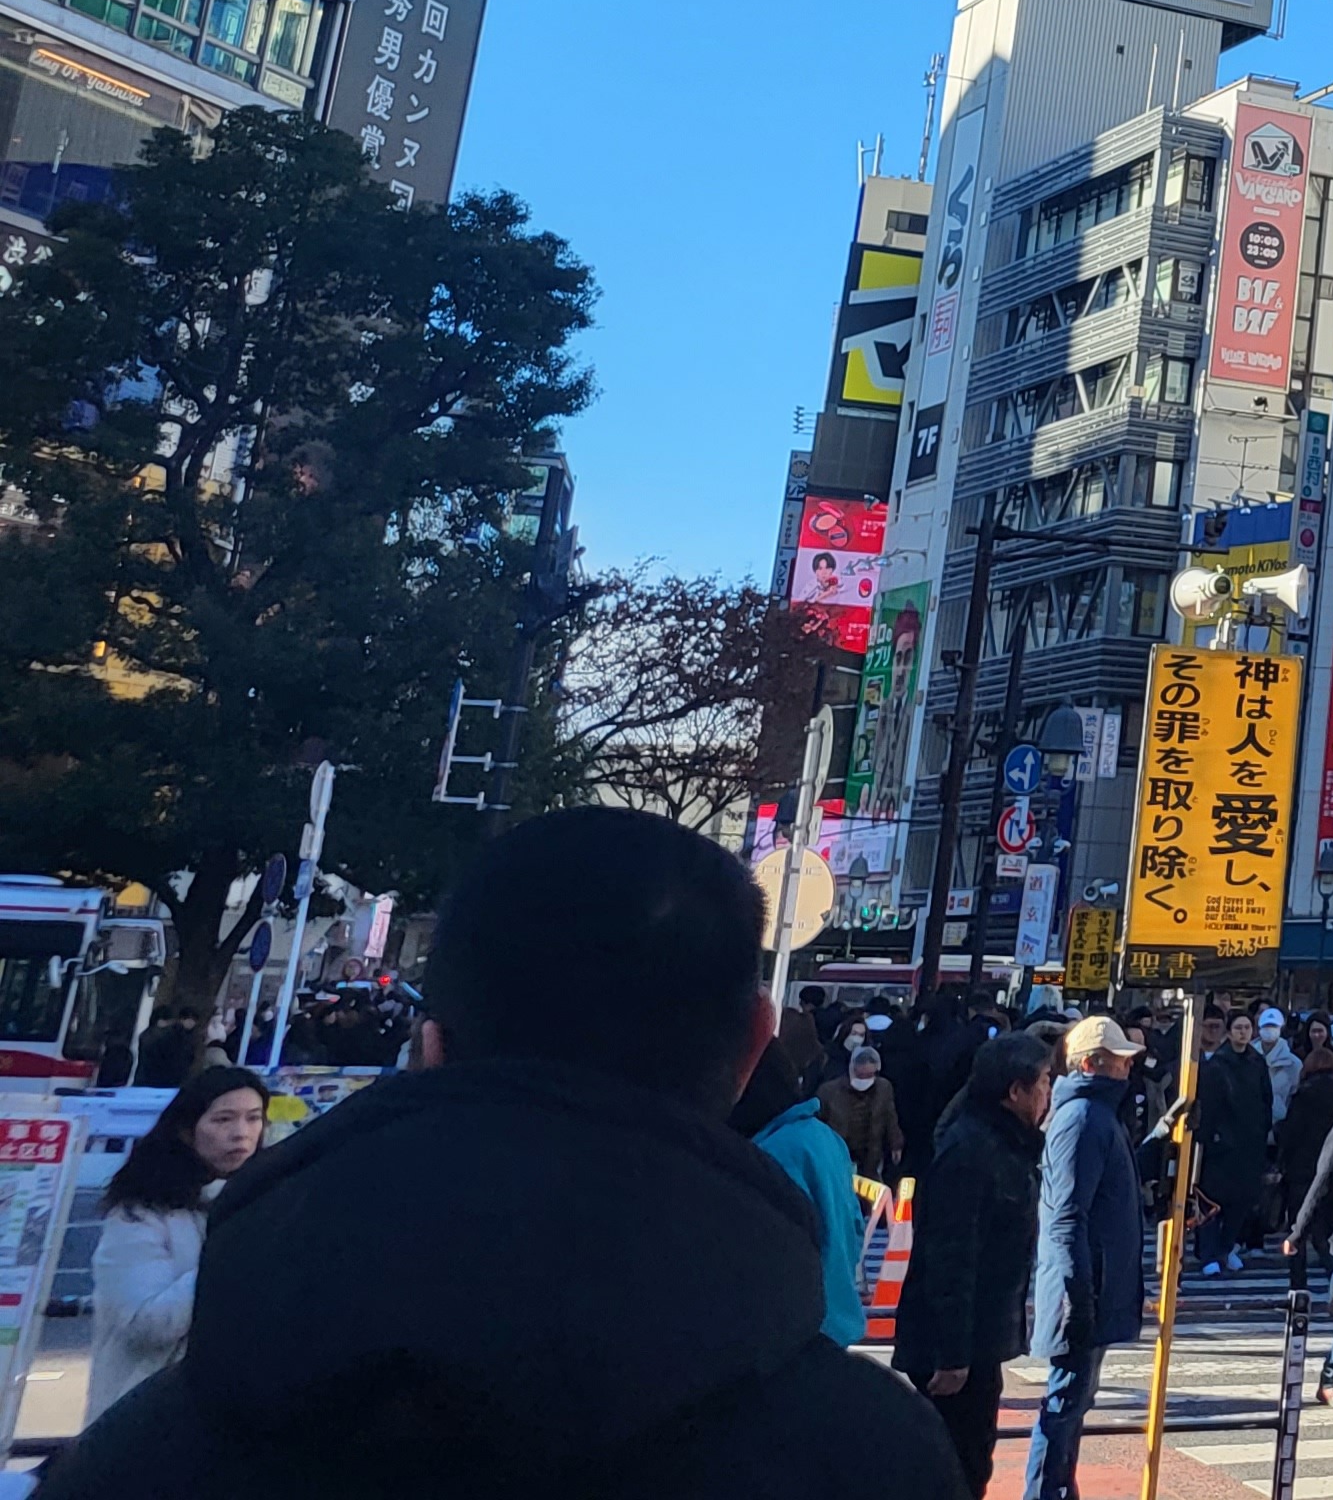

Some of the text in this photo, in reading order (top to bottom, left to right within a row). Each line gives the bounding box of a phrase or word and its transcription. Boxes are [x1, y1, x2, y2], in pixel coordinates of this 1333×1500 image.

[1235, 172, 1302, 208] VANGUARD
[1248, 233, 1280, 247] 10:00
[1237, 276, 1281, 305] B1F
[1233, 307, 1279, 336] B2F
[917, 424, 938, 458] 7F
[1139, 653, 1203, 925] その罪を取り除く。
[1207, 656, 1281, 893] 神は人を愛し、
[1205, 905, 1220, 913] and
[1246, 907, 1266, 916] away
[1206, 896, 1255, 908] God loves us
[1129, 952, 1197, 980] 聖書
